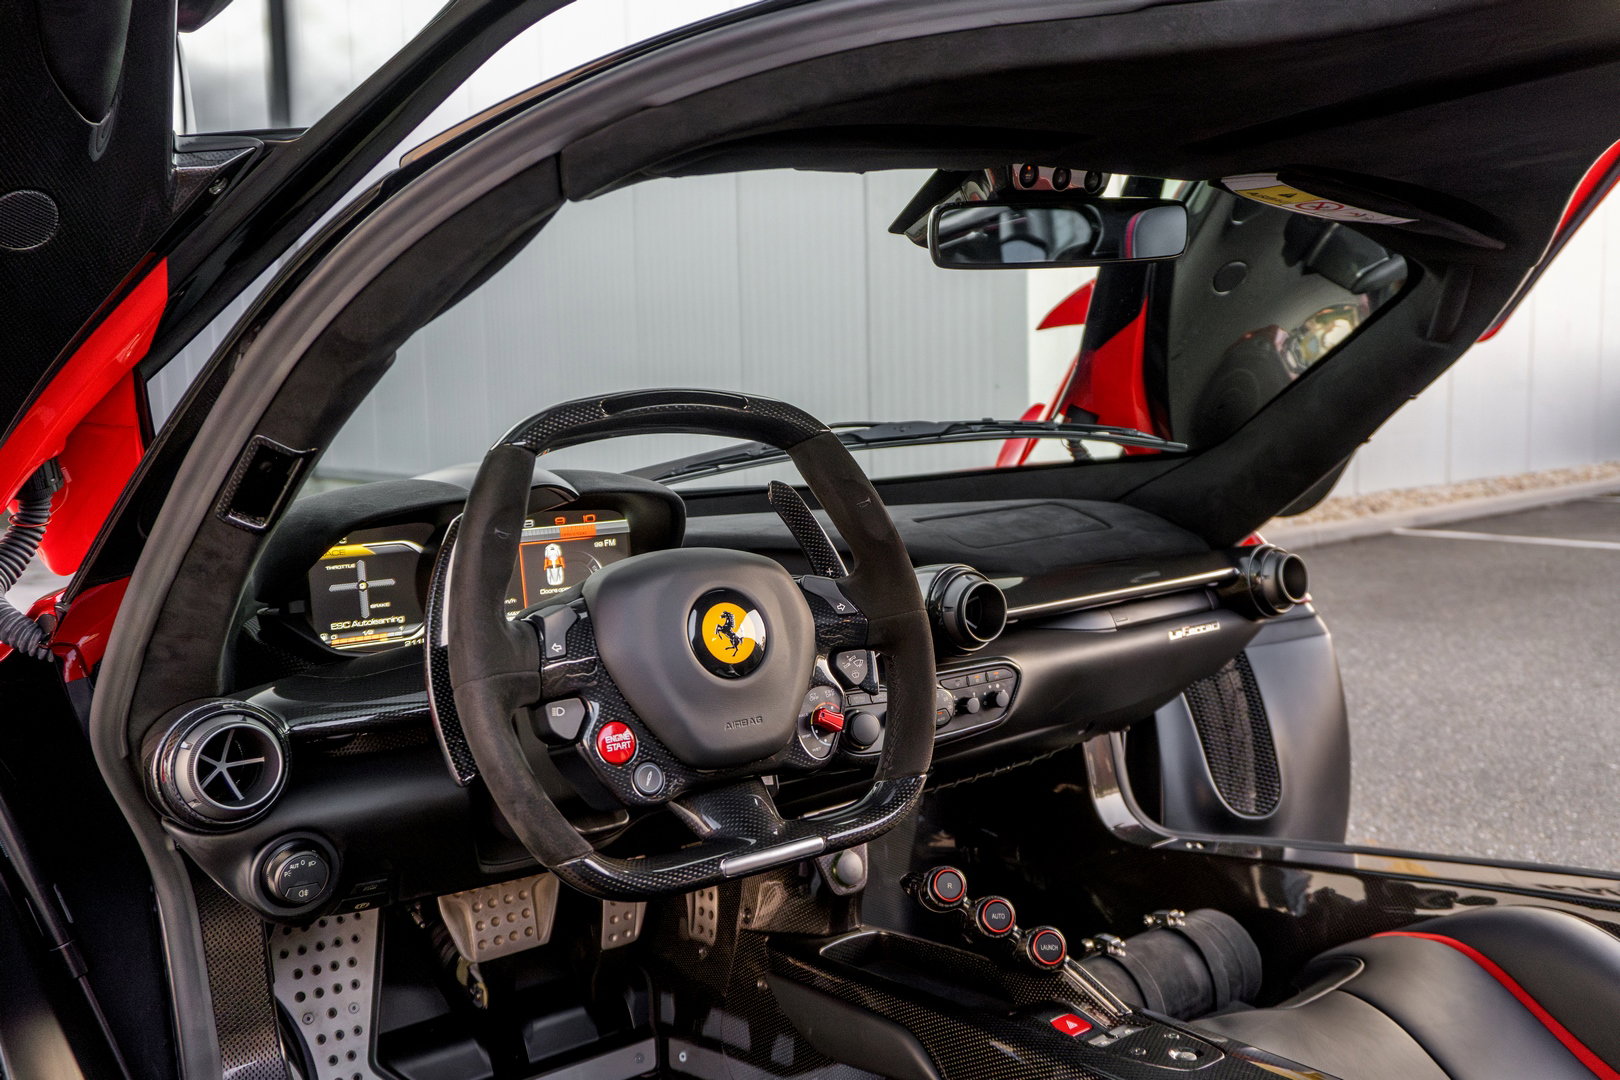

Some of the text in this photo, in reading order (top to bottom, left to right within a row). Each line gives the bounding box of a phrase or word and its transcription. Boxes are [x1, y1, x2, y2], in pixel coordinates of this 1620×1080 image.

[554, 516, 566, 525] 9
[583, 513, 596, 523] 10
[604, 538, 617, 547] FM
[323, 549, 345, 557] ACE
[325, 563, 356, 571] THROTTLE
[330, 616, 405, 631] ESC Autolearning
[724, 716, 764, 731] AIRBAG
[605, 732, 630, 743] ENGINE
[606, 741, 631, 752] START
